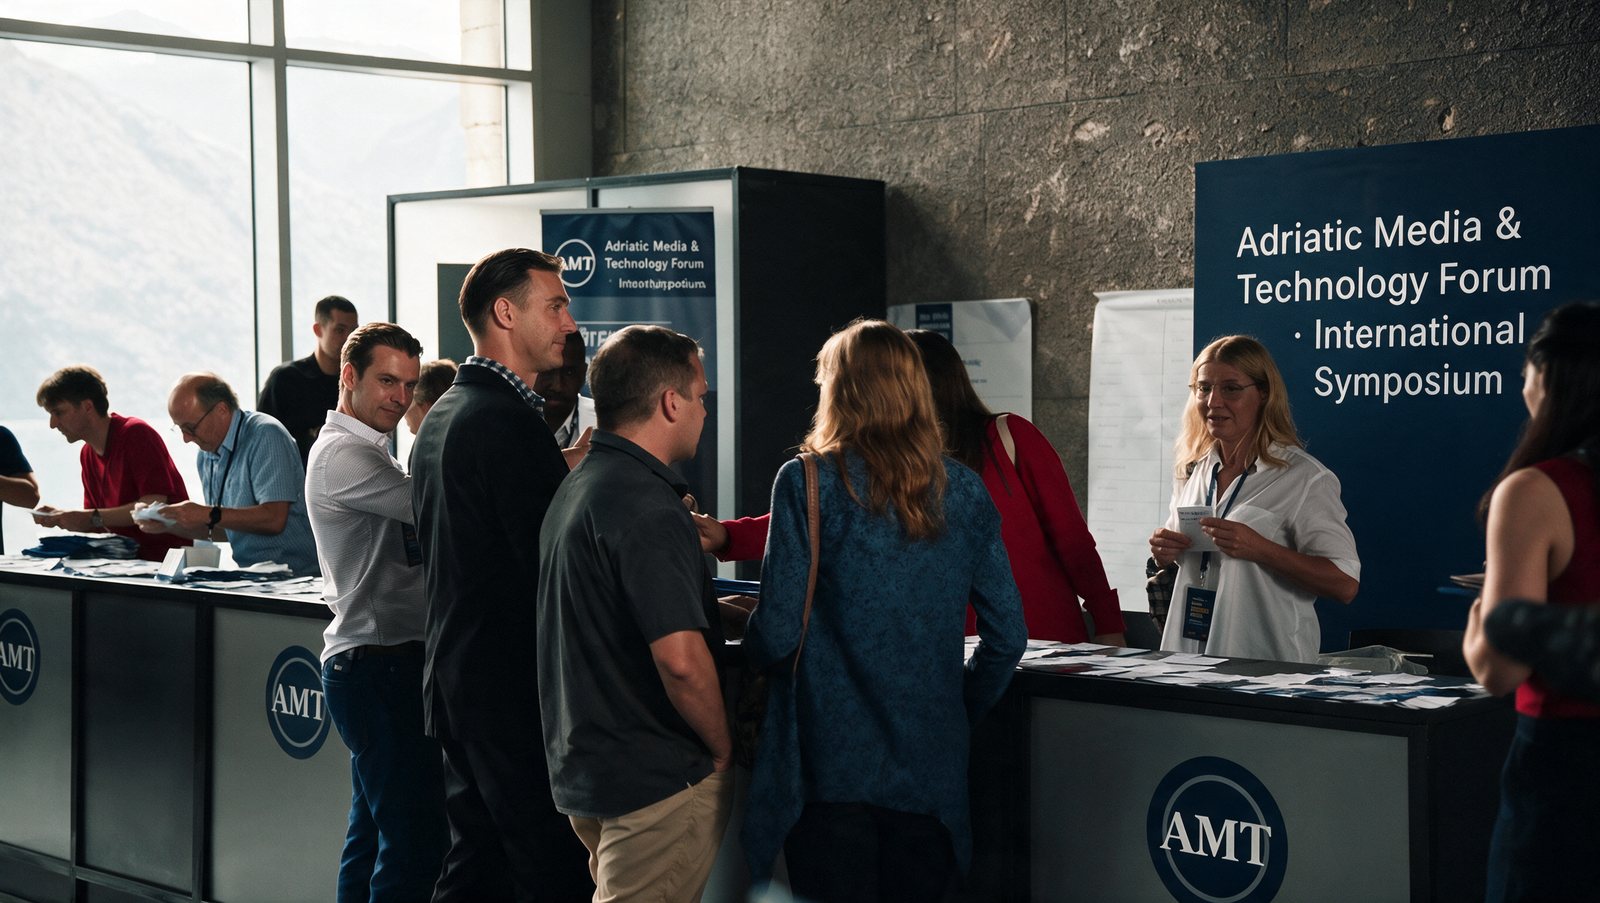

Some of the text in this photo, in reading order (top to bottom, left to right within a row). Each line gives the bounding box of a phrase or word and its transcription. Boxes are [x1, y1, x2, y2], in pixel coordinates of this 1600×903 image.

[605, 240, 700, 252] Adriatic Media &
[1236, 206, 1522, 258] Adriatic Media &
[605, 257, 704, 272] Technology Forum
[1237, 262, 1551, 306] Technology Forum
[1315, 312, 1526, 350] International
[1314, 363, 1503, 405] Symposium
[271, 683, 324, 721] AMT
[1159, 811, 1272, 867] AMT
